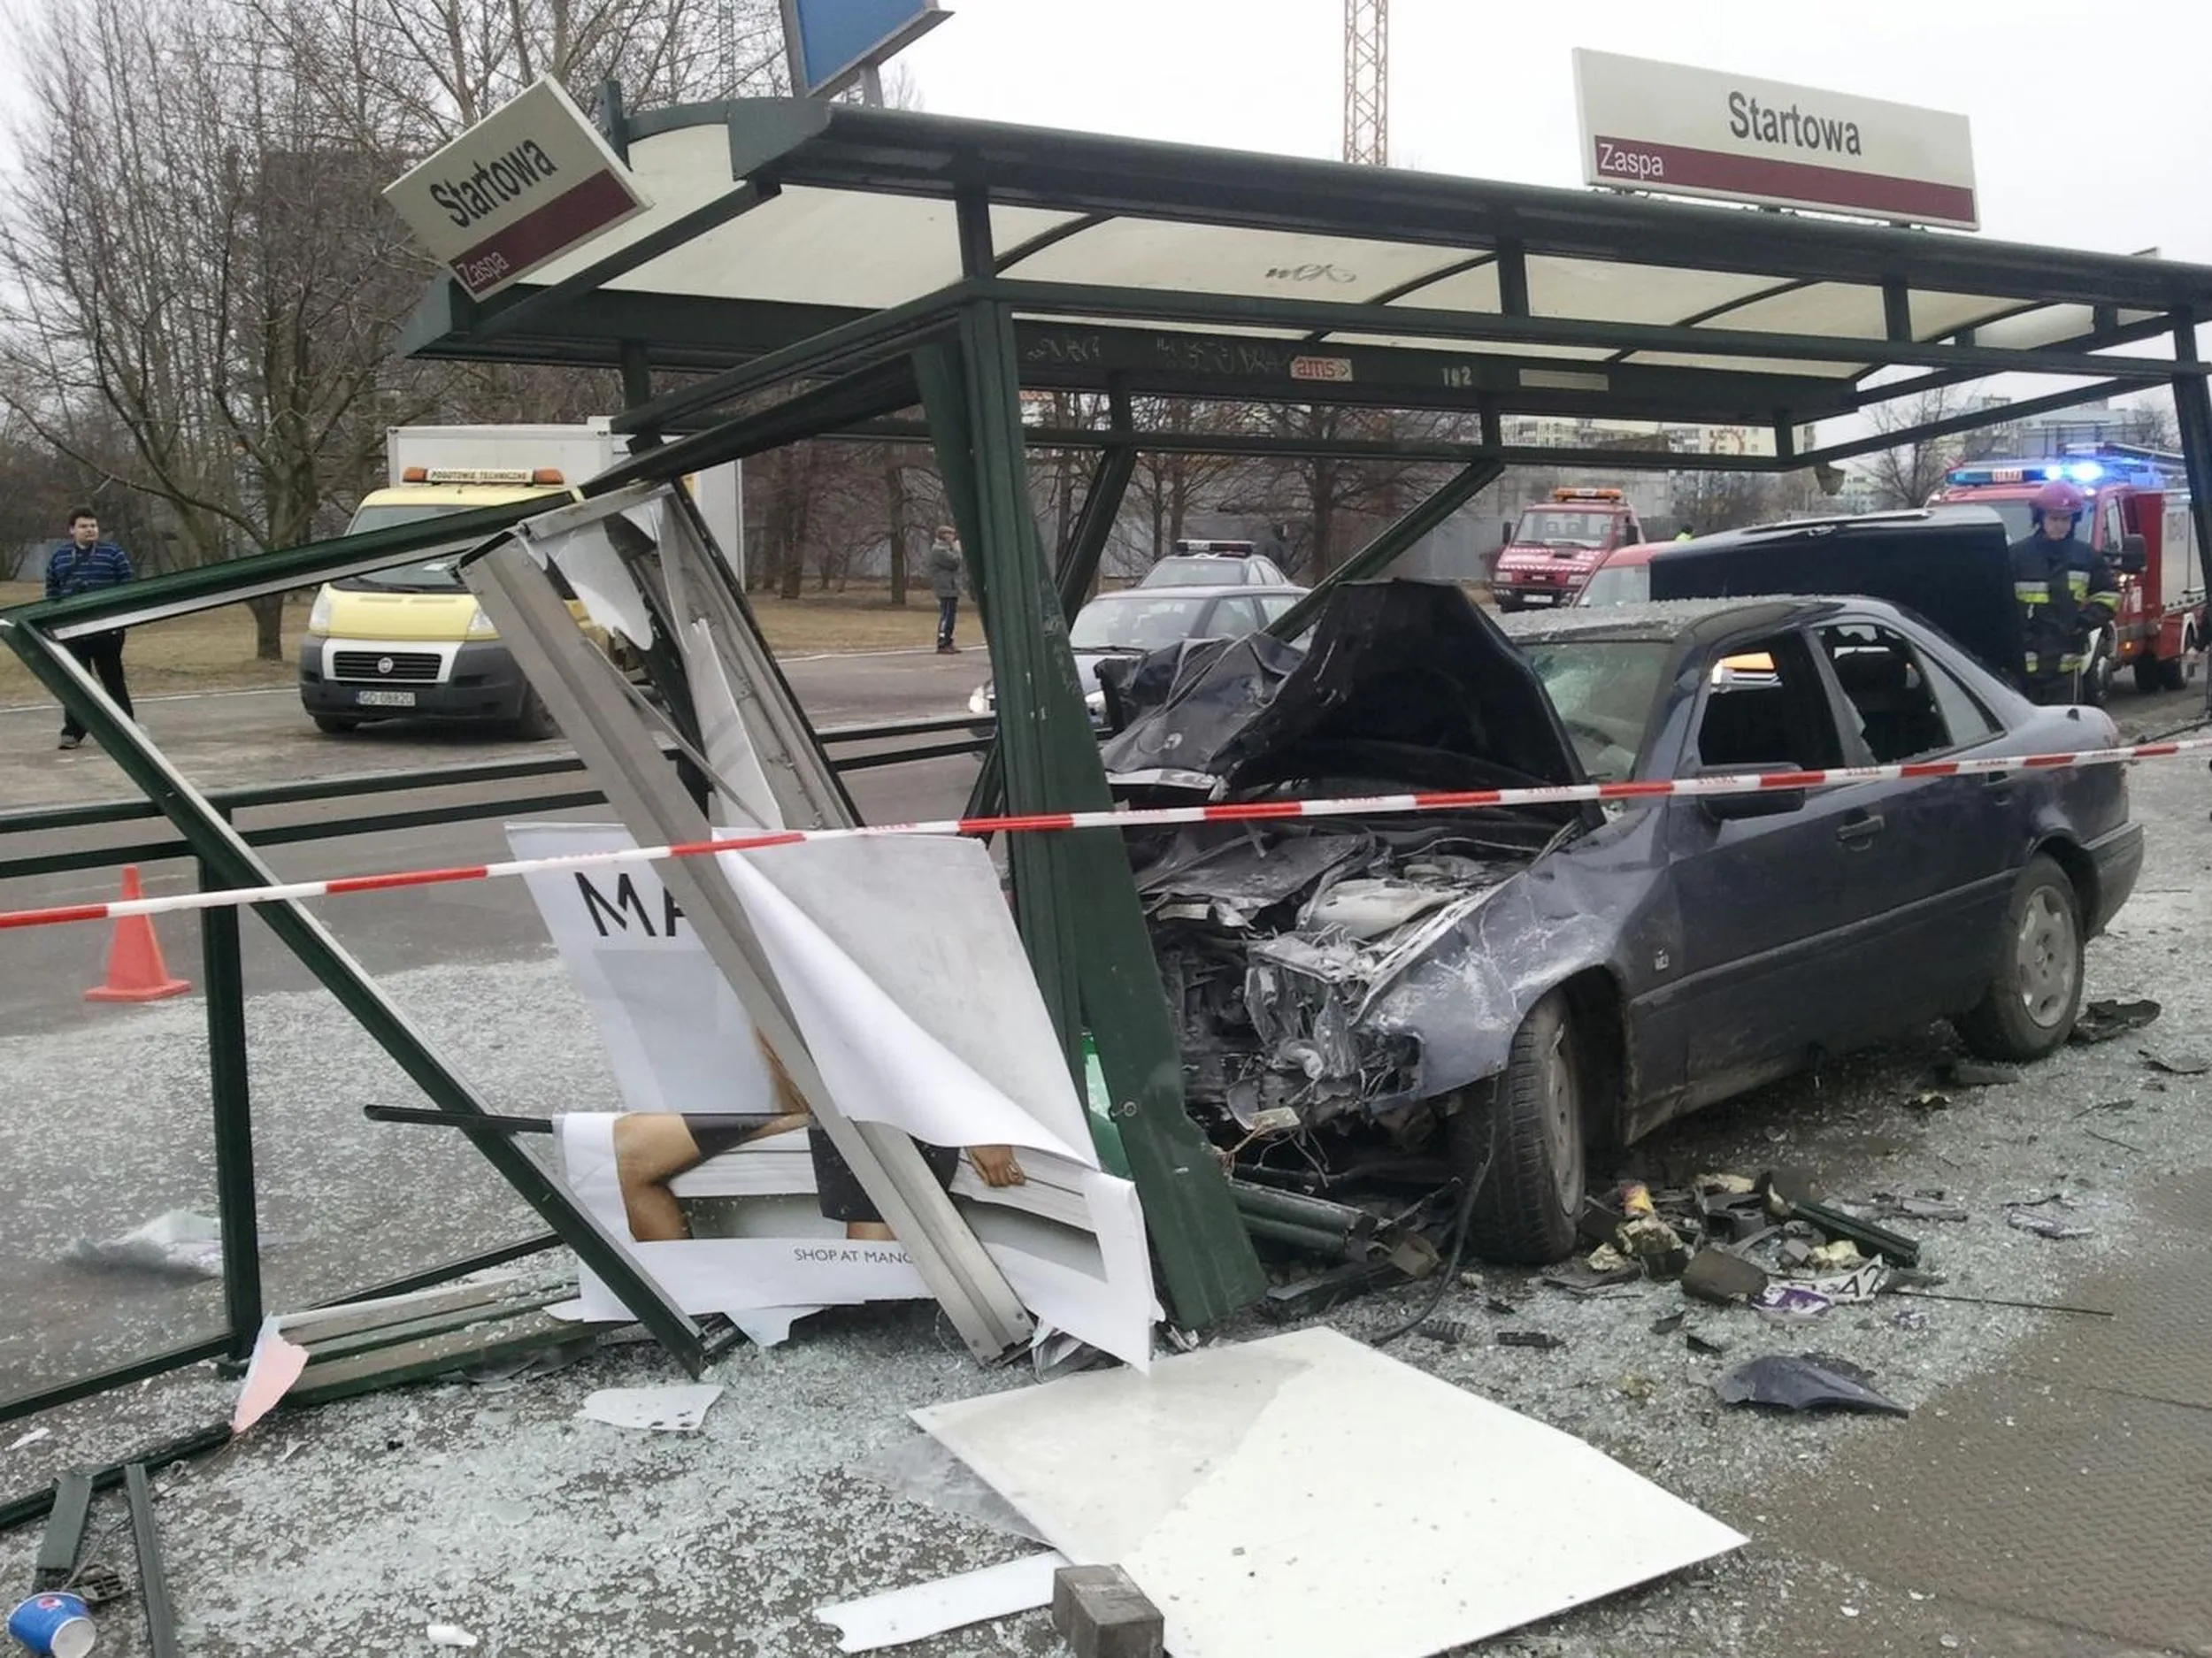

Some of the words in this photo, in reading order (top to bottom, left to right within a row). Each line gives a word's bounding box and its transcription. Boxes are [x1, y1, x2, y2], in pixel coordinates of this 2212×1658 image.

[1728, 90, 1863, 157] Startowa
[1599, 142, 1664, 180] Zaspa
[429, 139, 559, 228] Startowa
[456, 250, 511, 288] Zaspa
[794, 1248, 837, 1262] SHOP
[840, 1250, 859, 1263] AT
